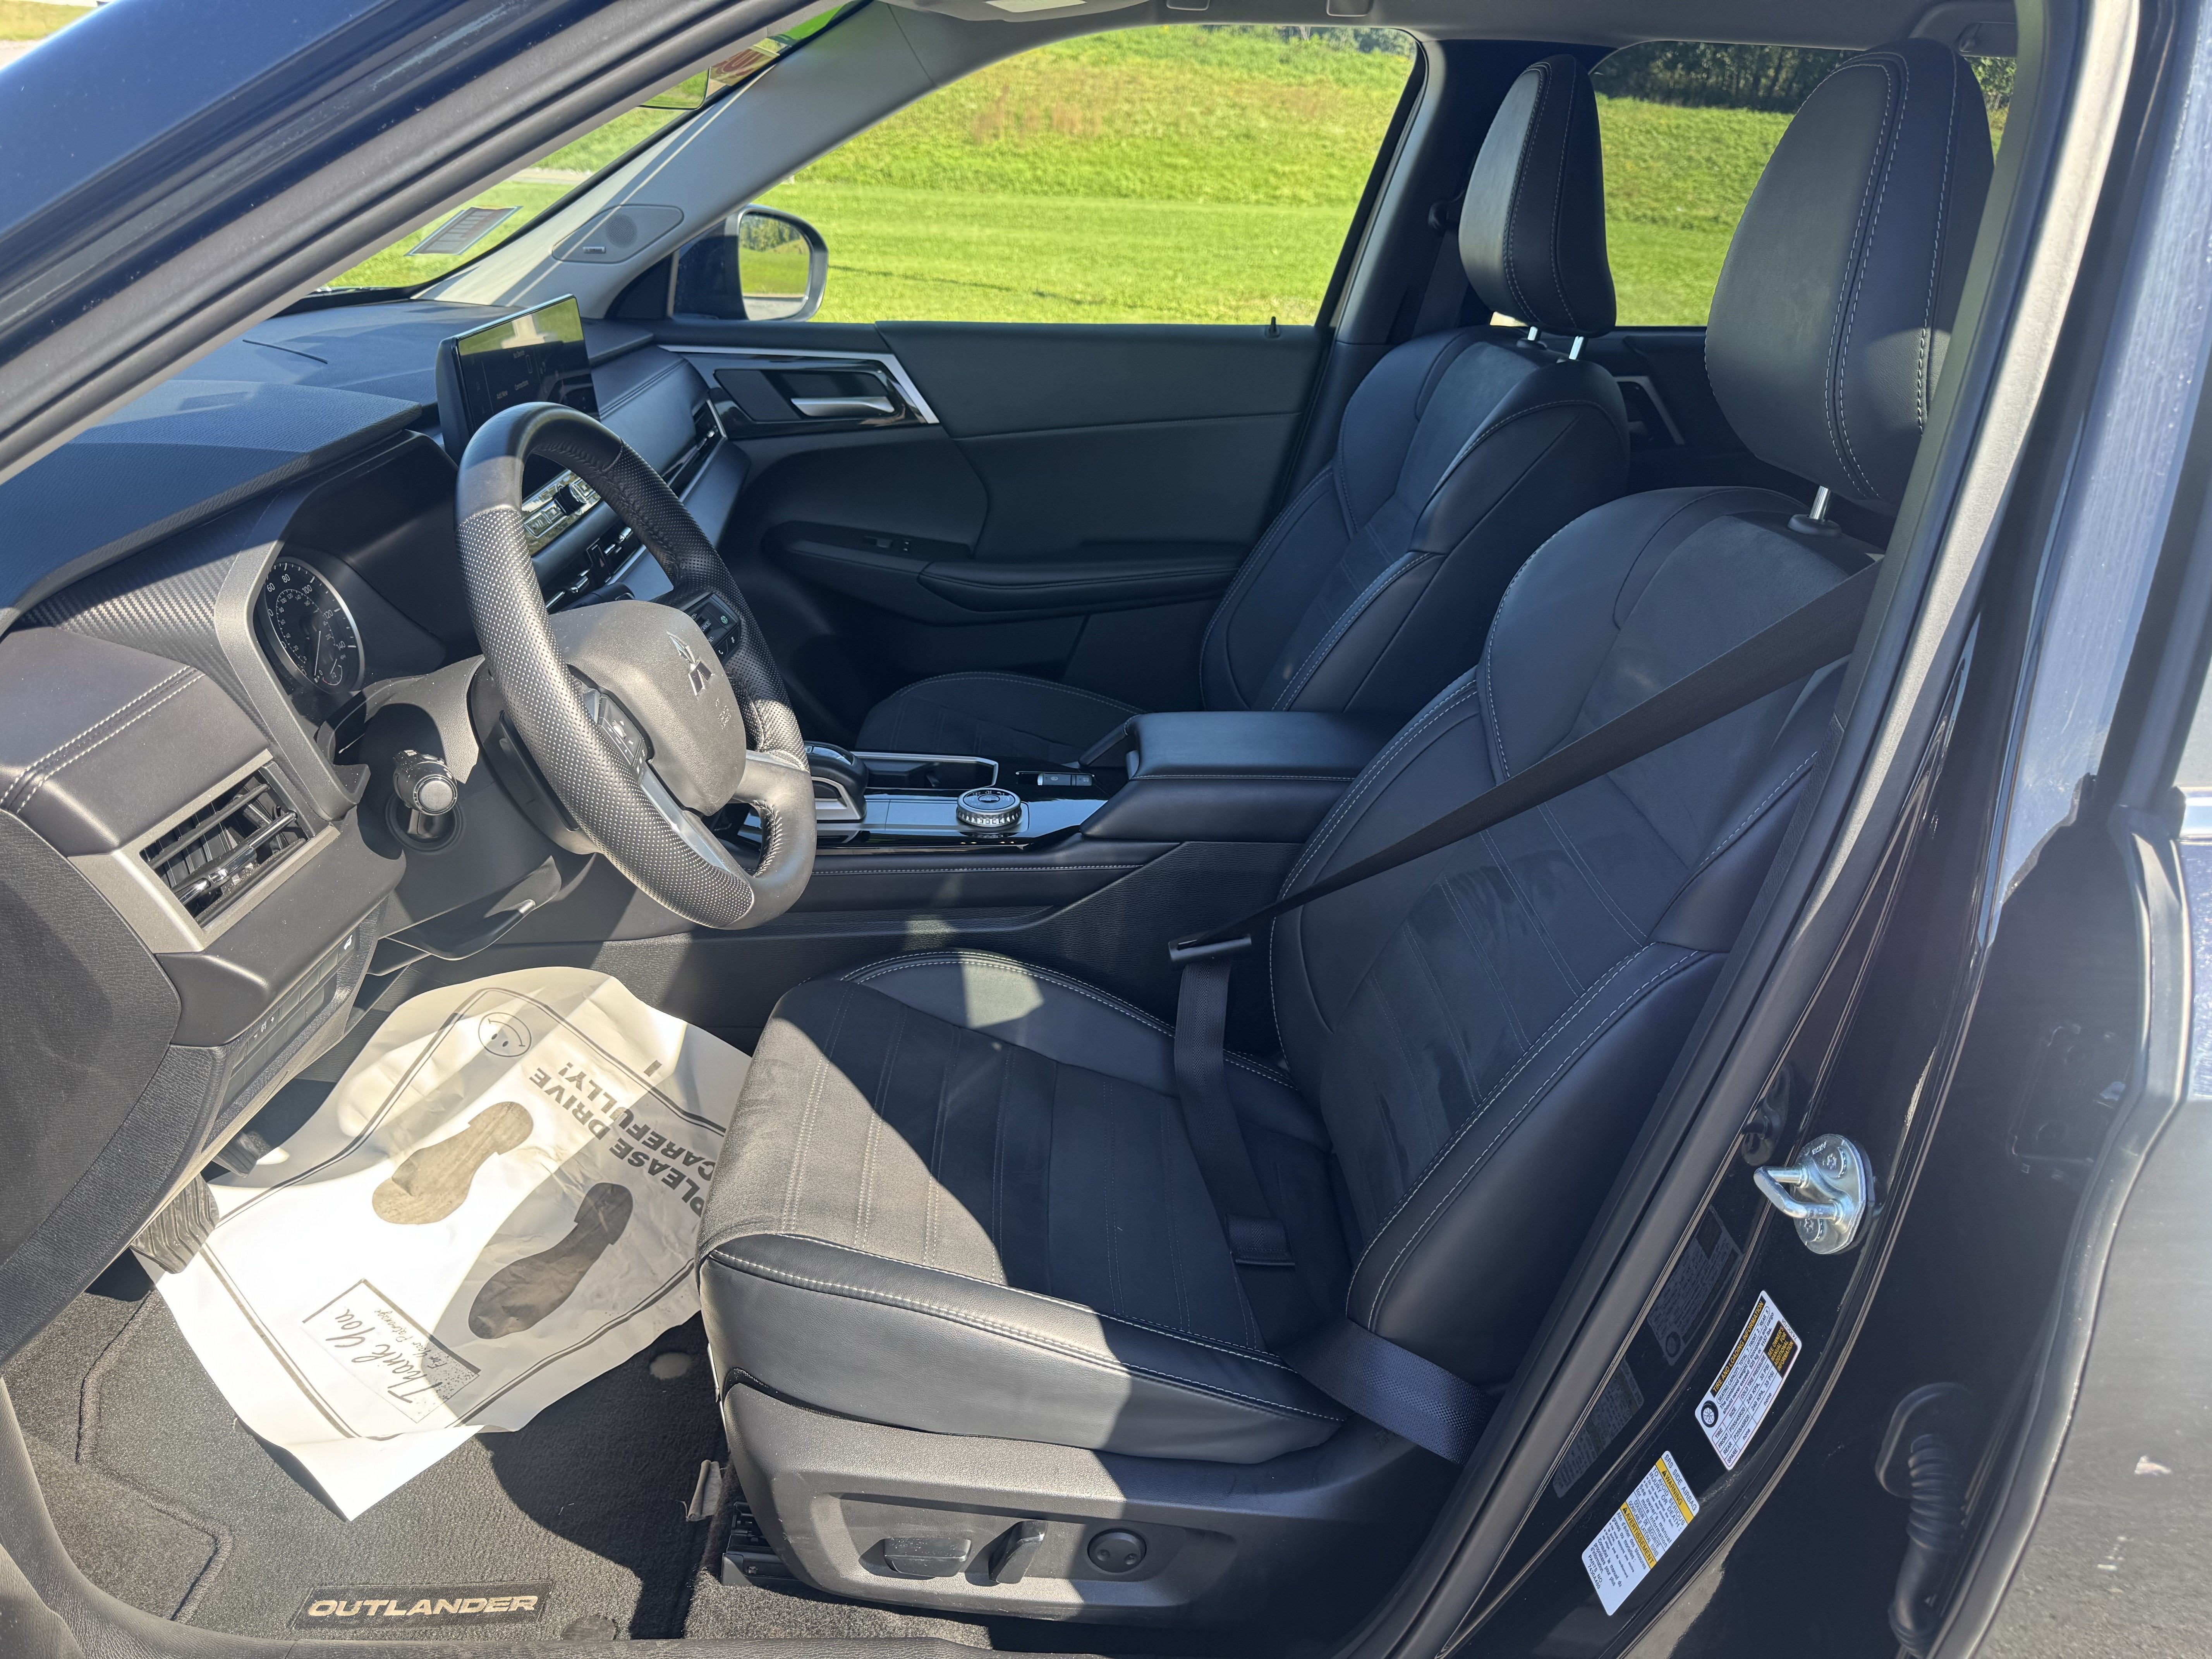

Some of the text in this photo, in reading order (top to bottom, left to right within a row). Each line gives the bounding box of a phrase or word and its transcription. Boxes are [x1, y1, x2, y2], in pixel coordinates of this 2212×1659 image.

[267, 582, 275, 592] 60
[282, 574, 290, 583] 80
[302, 584, 312, 594] 100
[323, 610, 333, 619] 120
[336, 641, 346, 651] 140
[529, 1067, 610, 1140] DRIVE
[558, 1062, 716, 1181] CAREFULLY!
[326, 1309, 443, 1403] Thank You
[1712, 1300, 1764, 1393] TIRE AND LOADING INFORMATION
[1725, 1378, 1739, 1401] combined
[1738, 1363, 1748, 1380] weight
[1749, 1335, 1763, 1360] occupants
[1766, 1311, 1774, 1327] cargo
[1770, 1341, 1782, 1362] MANUAL
[1772, 1325, 1784, 1348] OWNER'S
[1773, 1338, 1788, 1367] ADDITIONAL
[1776, 1340, 1793, 1372] INFORMATION
[427, 1356, 447, 1369] For
[1718, 1384, 1729, 1402] SEATING
[1728, 1366, 1740, 1386] CAPACITY
[1739, 1352, 1747, 1366] TOTAL
[1748, 1332, 1757, 1348] FRONT
[1722, 1398, 1733, 1415] should
[1732, 1385, 1741, 1399] never
[1739, 1369, 1750, 1387] exceed
[1753, 1353, 1759, 1361] kg
[1715, 1427, 1723, 1440] TIRE
[1740, 1386, 1749, 1400] COLD
[1752, 1354, 1766, 1378] PRESSURE
[1717, 1431, 1729, 1449] FRONT
[1759, 1372, 1765, 1381] 35
[1723, 1441, 1733, 1455] REAR
[1764, 1379, 1769, 1388] 35
[1726, 1391, 1772, 1464] SPARE none none
[1649, 1471, 1662, 1494] INJURY
[1660, 1494, 1668, 1505] OR
[1667, 1505, 1680, 1528] DEATH
[1652, 1467, 1685, 1526] TO AVOID SERIOUS
[1664, 1453, 1697, 1512] SRS SIDE AIRBAG
[1664, 1474, 1683, 1506] WARNING
[1611, 1516, 1621, 1532] graves
[1625, 1511, 1654, 1565] AVERTISSEMENT
[1633, 1499, 1661, 1549] COUSSIN DE SÉCURITÉ
[1640, 1498, 1650, 1514] more
[1649, 1514, 1668, 1548] information
[1640, 1524, 1652, 1544] LATÉRAL
[1650, 1543, 1659, 1558] (SRS)
[1645, 1497, 1659, 1521] owner's
[1658, 1521, 1672, 1544] manual
[1588, 1554, 1598, 1573] PARTS
[1634, 1547, 1647, 1570] blessures
[308, 1595, 538, 1616] OUTLANDER
